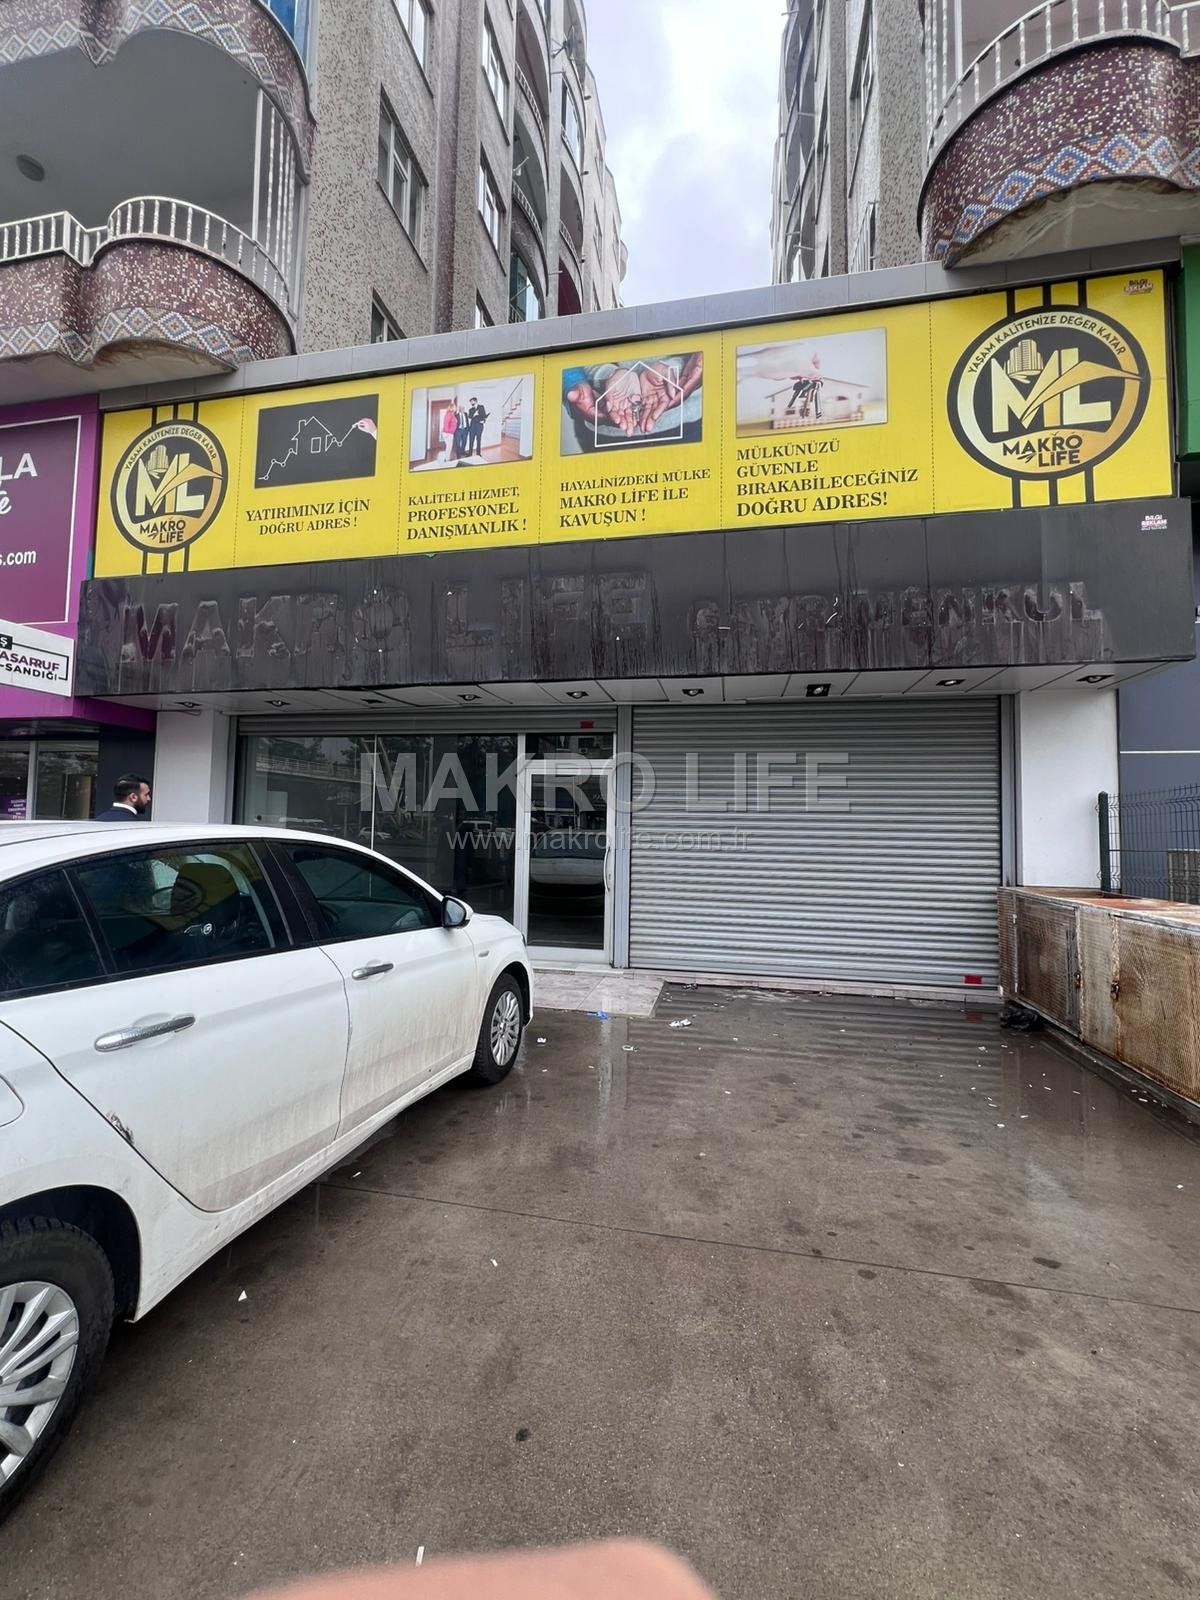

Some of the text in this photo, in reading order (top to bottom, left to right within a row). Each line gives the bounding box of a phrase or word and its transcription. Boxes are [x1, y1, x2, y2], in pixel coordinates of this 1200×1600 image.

[1097, 326, 1126, 355] KATAR
[736, 440, 841, 461] MÜLKÜNÜZÜ
[1003, 434, 1083, 456] MAKRO
[736, 460, 819, 479] GÜVENLE
[560, 473, 659, 492] HAYALİNİZDEKİ
[736, 468, 919, 497] BIRAKABİLECEĞİNİZ
[408, 490, 466, 506] KALİTELİ
[560, 487, 689, 510] MAKRO LİFE İLE
[736, 491, 888, 517] DOĞRU ADRES!
[245, 497, 370, 522] YATIRIMINIZ İÇİN
[408, 502, 519, 523] PROFESYONEL
[560, 509, 637, 528] KAVUŞUN
[140, 519, 186, 534] MAKRO
[259, 521, 304, 536] DOĞRU
[307, 517, 351, 532] ADRES
[407, 519, 519, 540] DANIŞMANLIK
